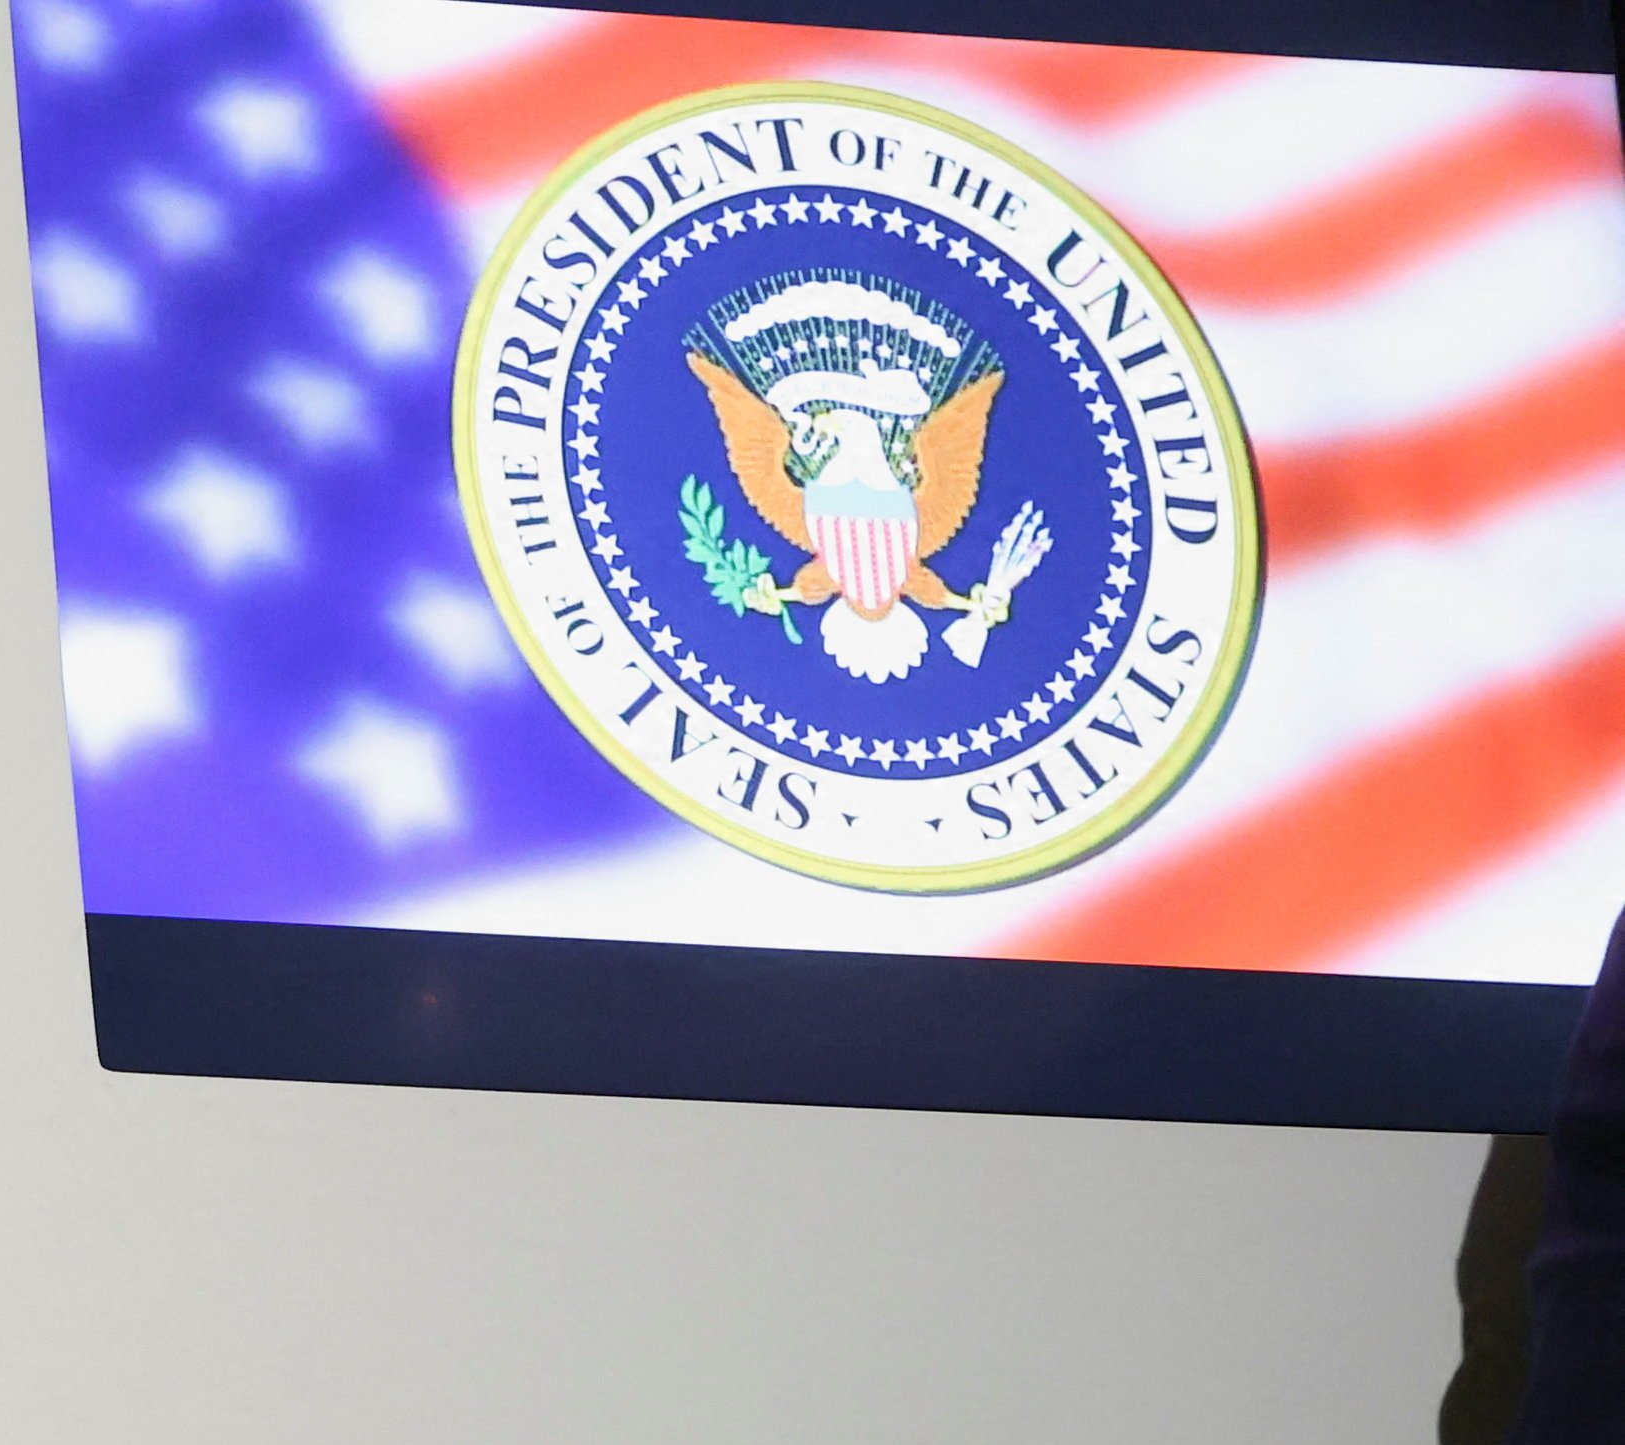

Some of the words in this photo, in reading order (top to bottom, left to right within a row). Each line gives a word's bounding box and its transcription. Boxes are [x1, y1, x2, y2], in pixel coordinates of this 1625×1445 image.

[828, 128, 902, 172] OF
[925, 150, 1028, 232] THE
[492, 117, 804, 431] PRESIDENT
[1046, 226, 1219, 545] UNITED
[502, 454, 558, 567] THE
[544, 594, 605, 657] OF
[618, 661, 818, 830] SEAL
[966, 613, 1203, 840] STATES
